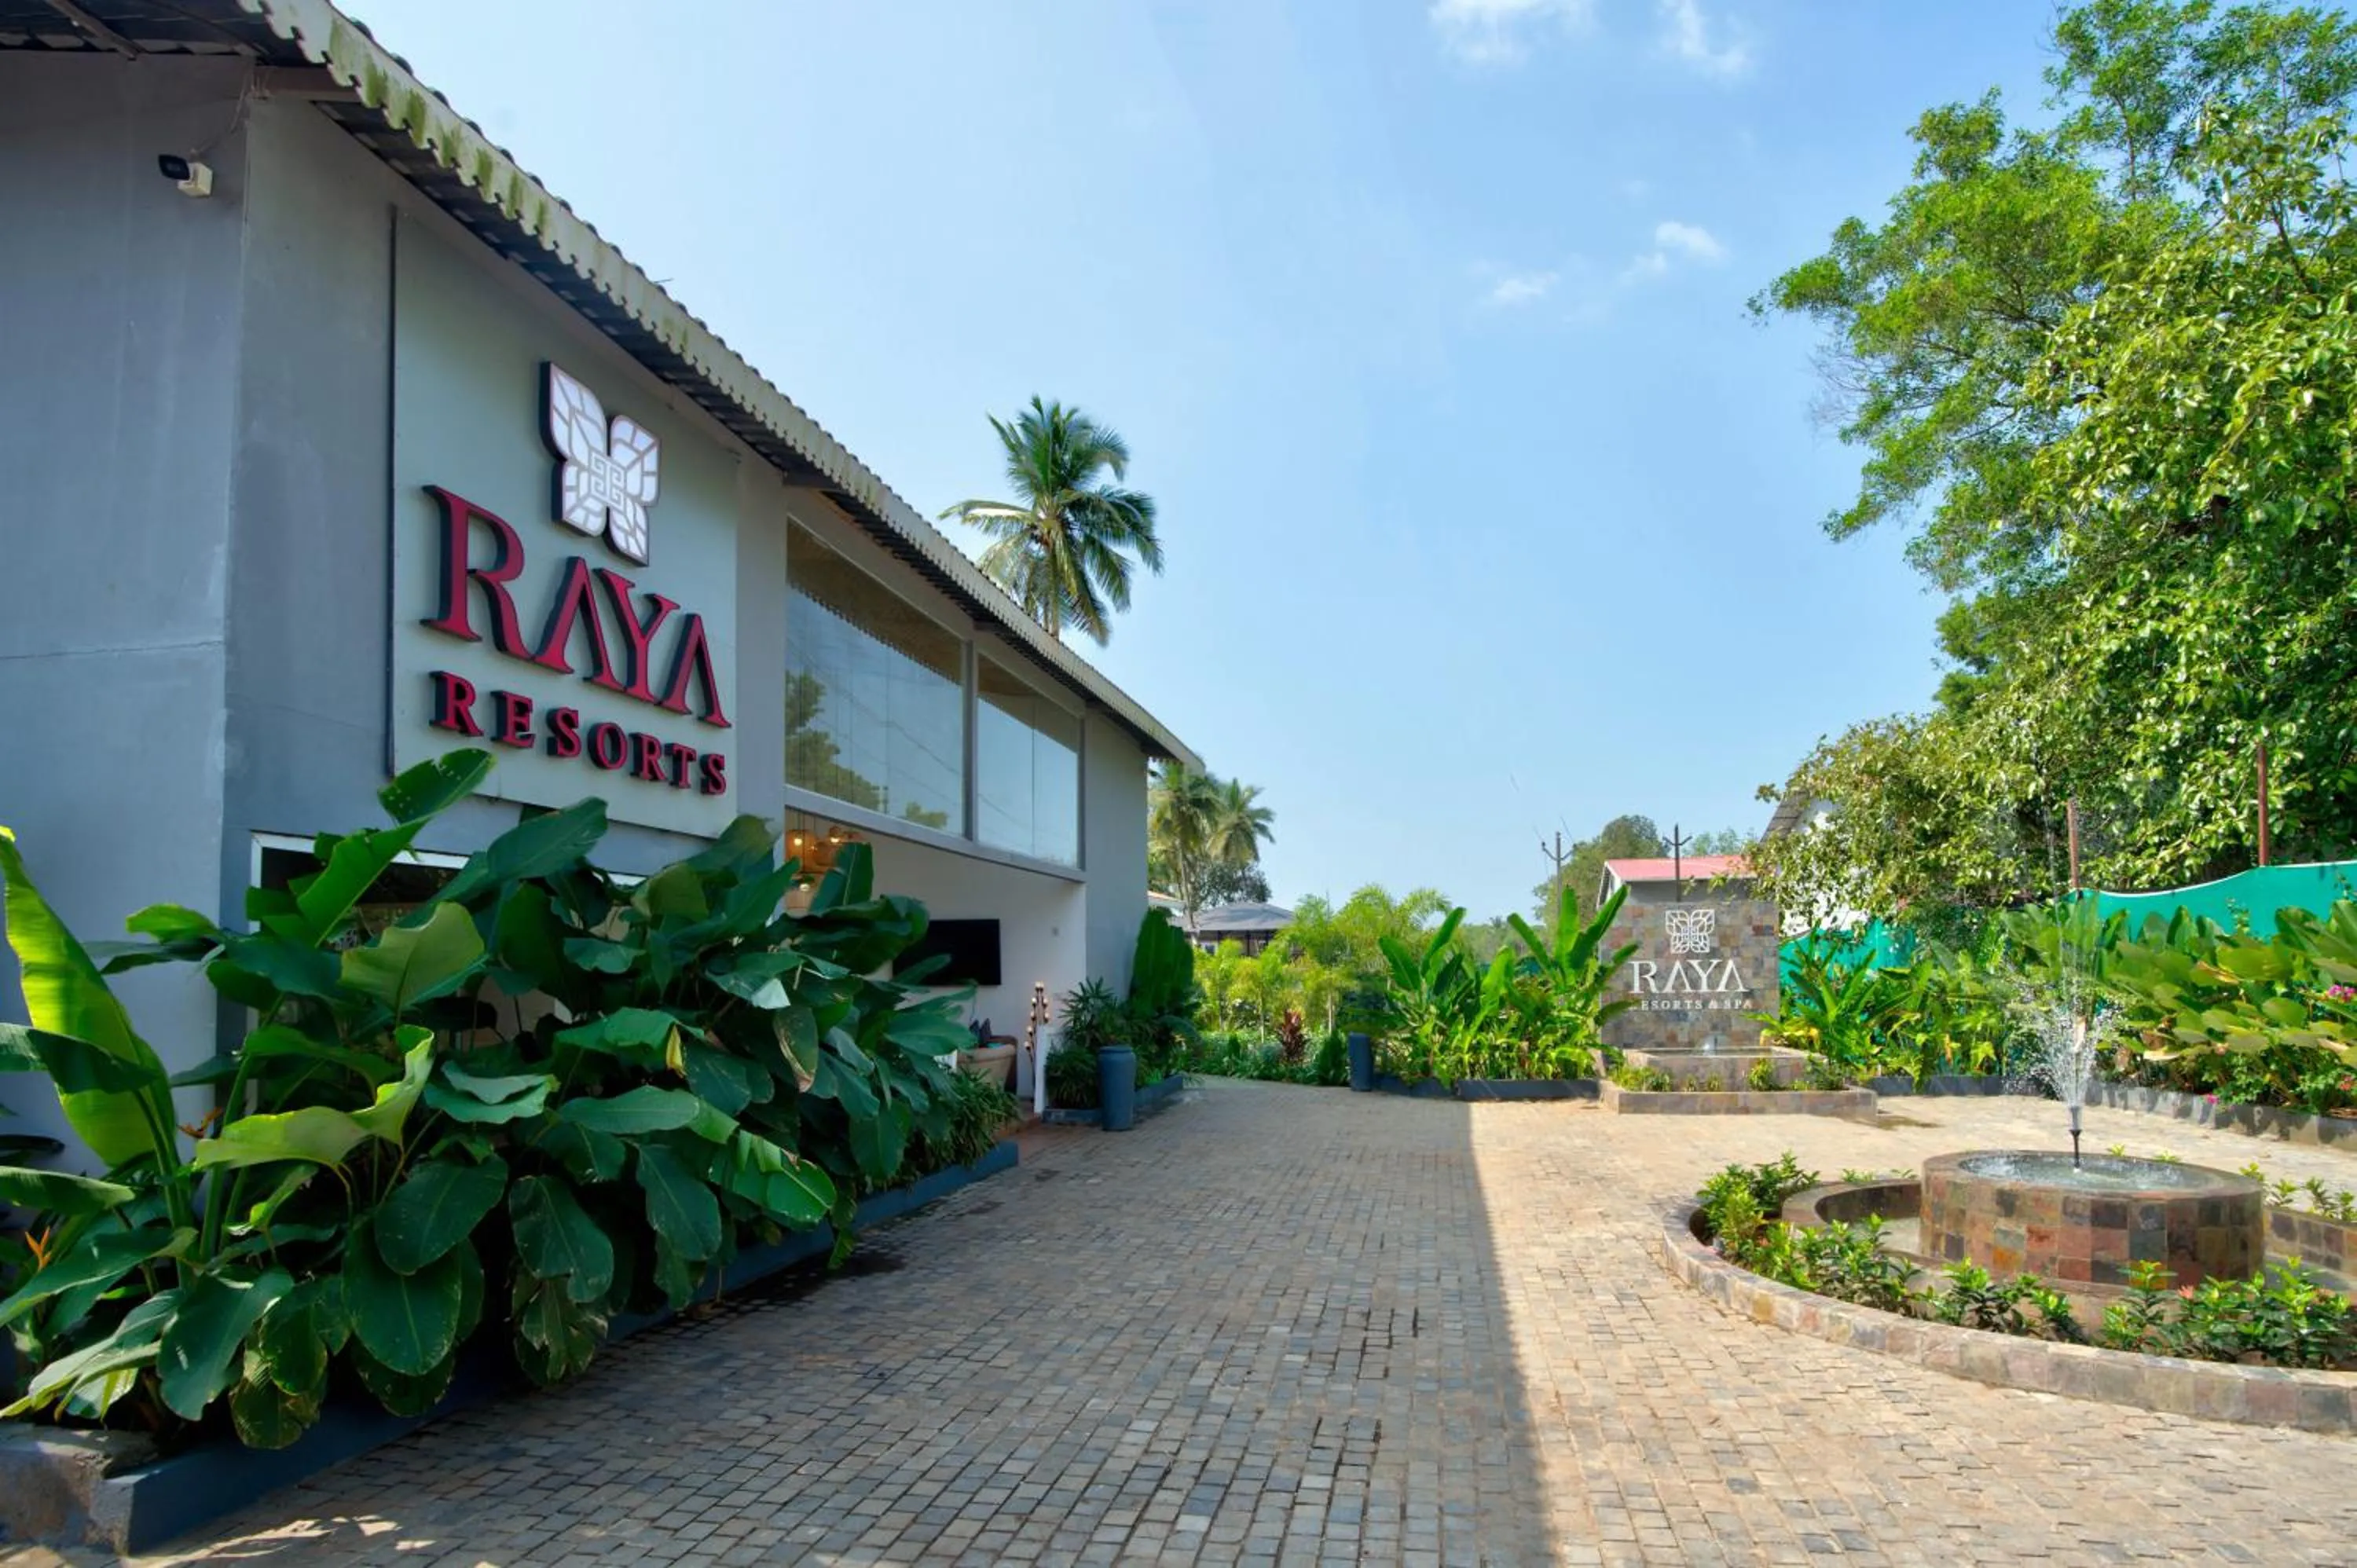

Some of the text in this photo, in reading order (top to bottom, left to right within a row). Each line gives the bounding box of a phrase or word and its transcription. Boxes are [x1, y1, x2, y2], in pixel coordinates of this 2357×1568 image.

[420, 484, 731, 728] RAYA
[428, 669, 726, 796] RESORTS
[1628, 958, 1750, 994] RAYA
[1628, 998, 1753, 1011] ESORTS & SPA
